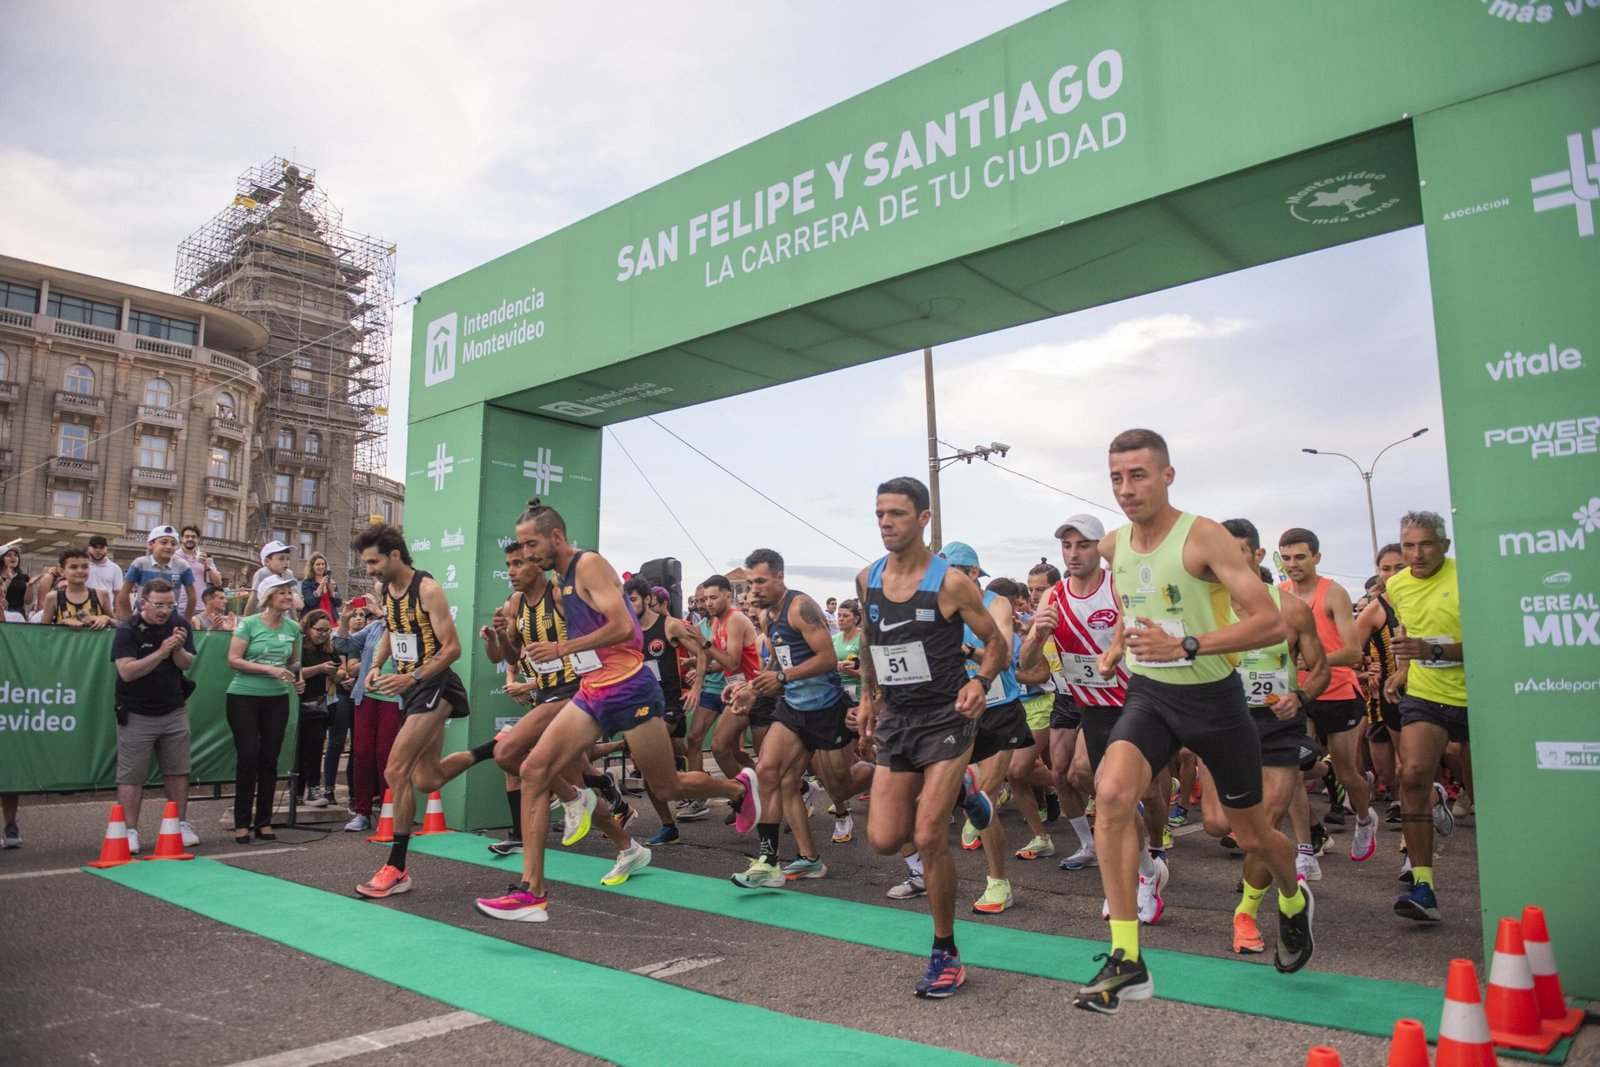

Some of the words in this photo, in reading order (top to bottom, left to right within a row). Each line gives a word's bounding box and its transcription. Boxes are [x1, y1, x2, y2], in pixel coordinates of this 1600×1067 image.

[617, 225, 678, 282] SAN
[689, 169, 815, 256] FELIPE
[825, 153, 853, 200] Y
[863, 49, 1123, 187] SANTIAGO
[705, 254, 735, 287] LA
[741, 205, 869, 273] CARRERA
[879, 184, 919, 226] DE
[928, 165, 970, 207] TU
[983, 111, 1127, 188] CIUDAD
[1443, 198, 1510, 221] ASOCIACION
[463, 287, 545, 336] Intendencia
[462, 320, 545, 365] Montevideo
[1486, 342, 1583, 381] vitale
[1484, 416, 1600, 448] POWER
[1531, 434, 1598, 459] ADE
[1520, 592, 1599, 613] CEREAL
[1523, 612, 1600, 648] MIX
[397, 642, 407, 653] 10
[888, 656, 908, 674] 51
[1083, 664, 1095, 678] 3
[1251, 681, 1274, 695] 29
